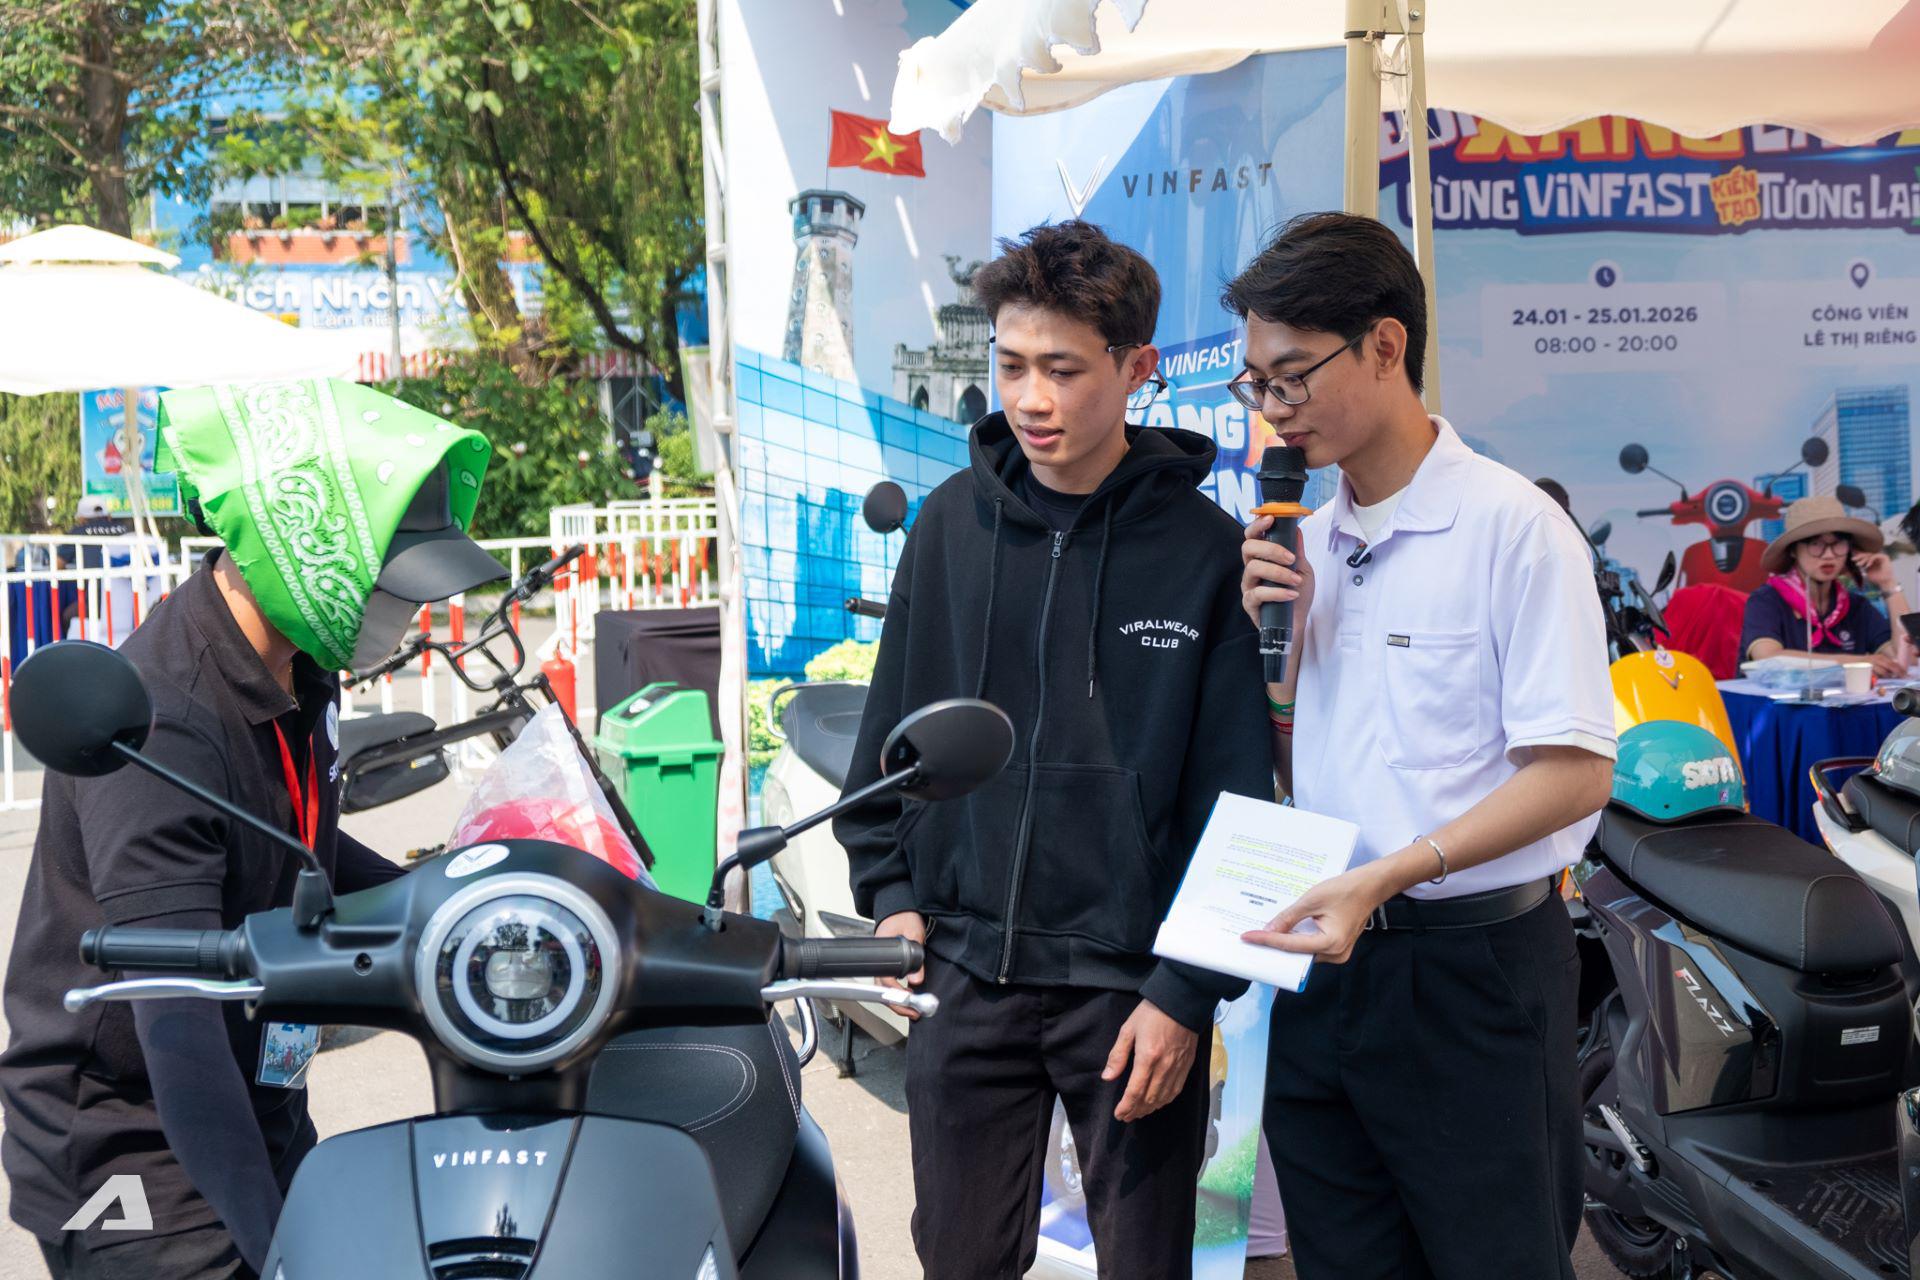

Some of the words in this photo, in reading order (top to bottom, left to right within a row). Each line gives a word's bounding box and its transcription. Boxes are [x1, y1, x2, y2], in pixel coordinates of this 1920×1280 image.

[1122, 162, 1273, 199] VINFAST
[1407, 175, 1520, 221] ÙNG
[1513, 309, 1567, 325] 24.01
[1588, 307, 1698, 324] 25.01.2026
[1812, 303, 1863, 321] CÔNG
[1868, 302, 1909, 320] VIÊN
[1535, 337, 1596, 354] 08:00
[1618, 335, 1678, 352] 20:00
[1804, 329, 1825, 346] LÊ
[1831, 331, 1858, 349] THỊ
[1864, 327, 1917, 344] RIÊNG
[1165, 338, 1242, 378] VINFAST
[1119, 619, 1200, 641] VIRALWEAR
[1141, 636, 1179, 649] CLUB
[1675, 966, 1735, 1038] FLAZZ
[433, 1149, 548, 1169] VINFAST
